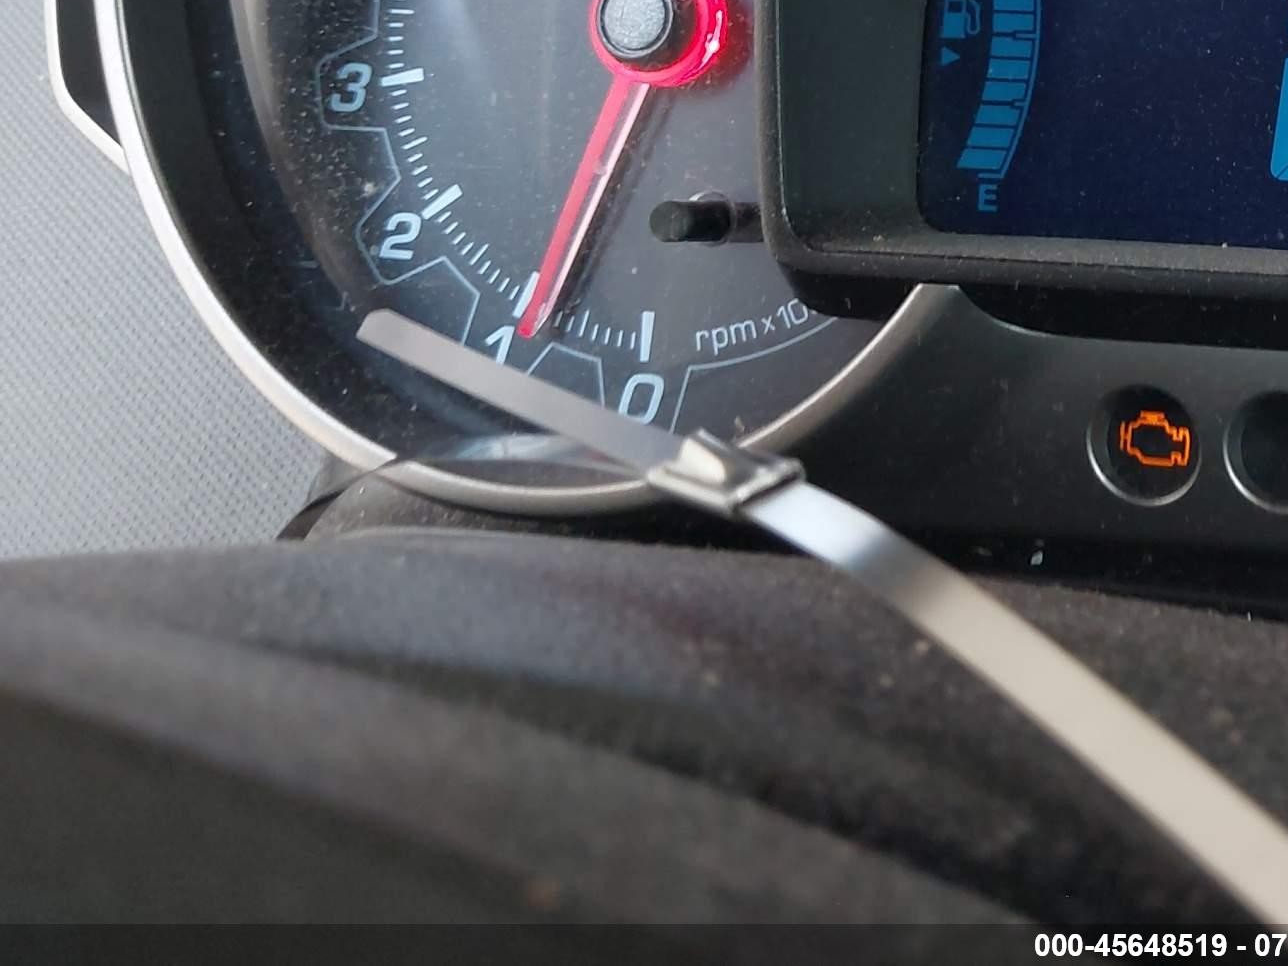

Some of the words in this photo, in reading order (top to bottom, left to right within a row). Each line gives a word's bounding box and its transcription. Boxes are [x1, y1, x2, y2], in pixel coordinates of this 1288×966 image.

[329, 63, 371, 113] 3
[977, 185, 998, 212] E
[378, 213, 423, 260] 2
[484, 325, 516, 365] 1
[694, 319, 758, 356] rpm
[617, 373, 665, 425] 0
